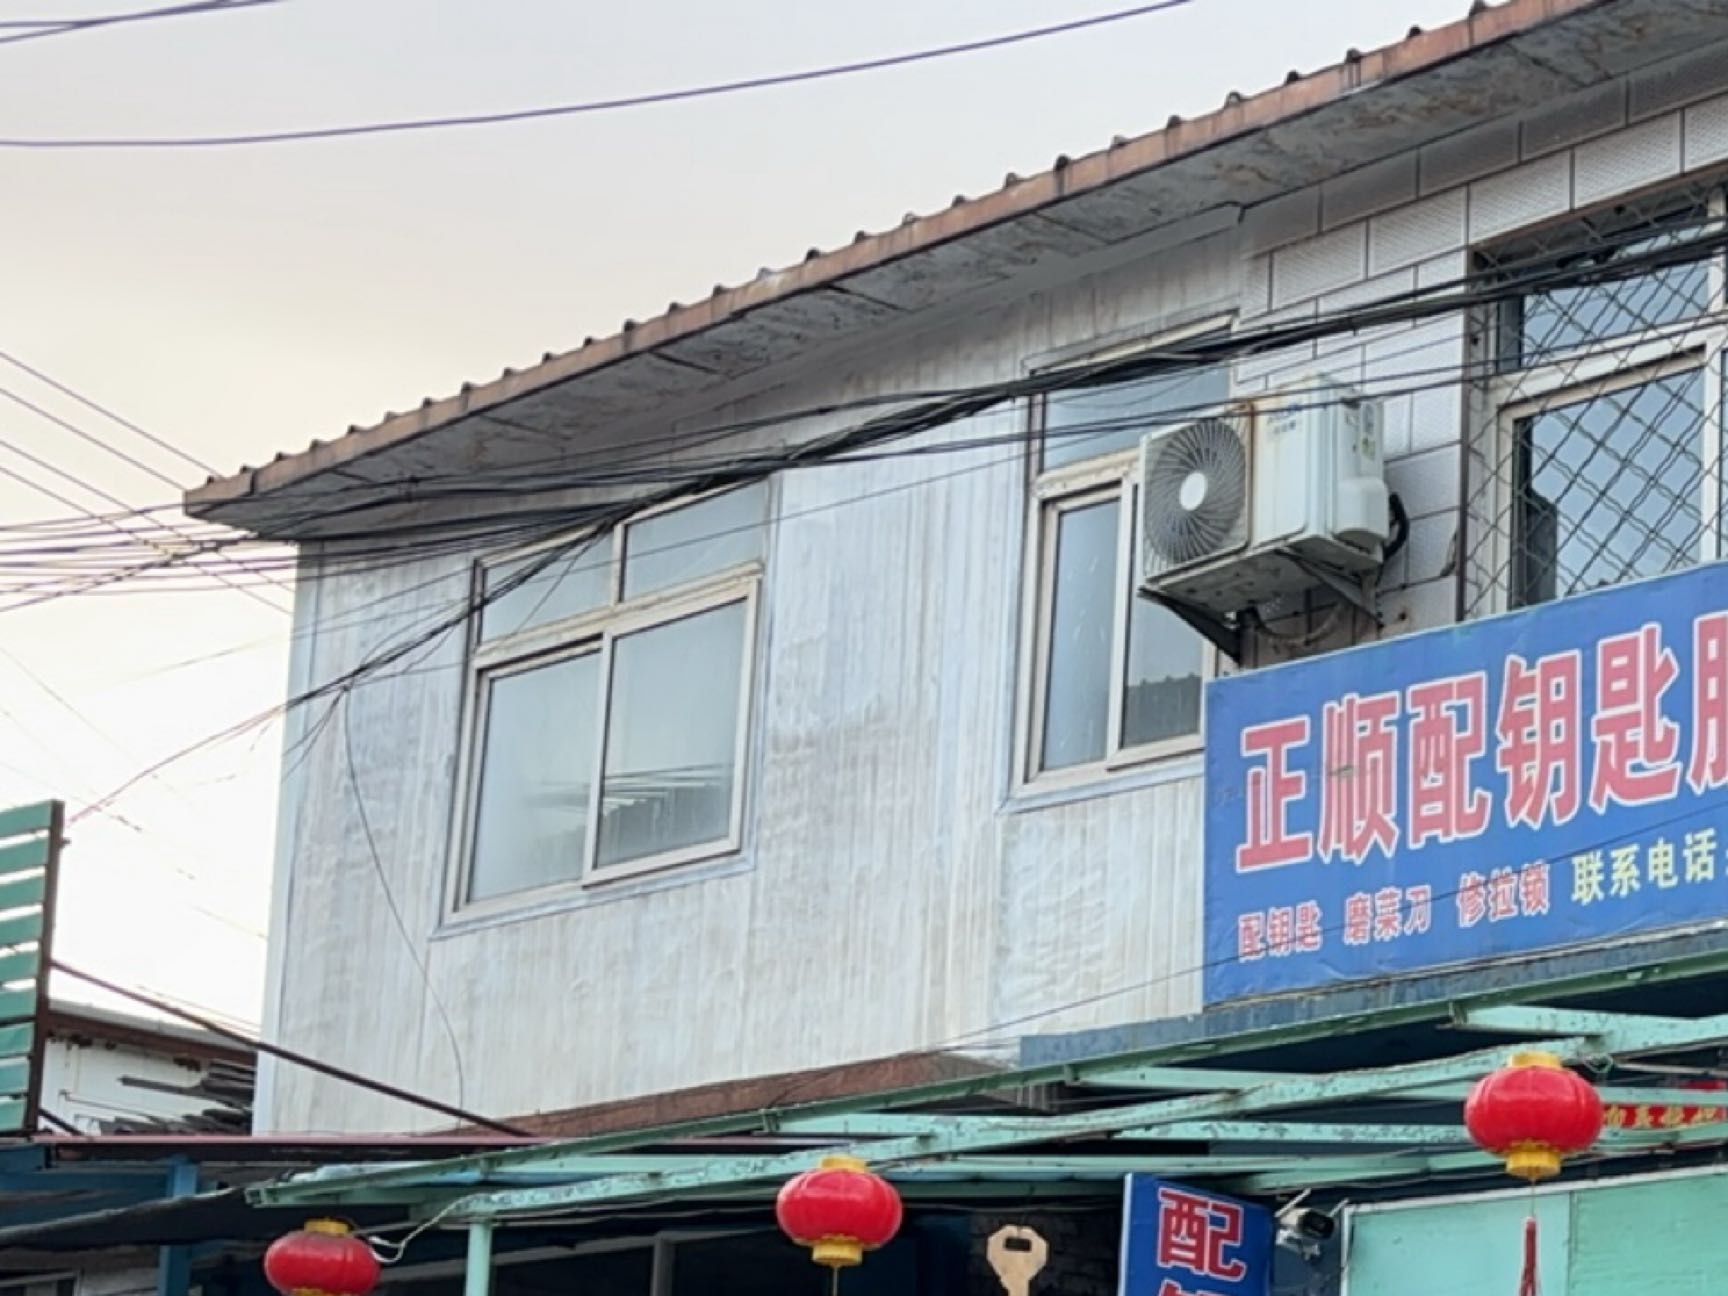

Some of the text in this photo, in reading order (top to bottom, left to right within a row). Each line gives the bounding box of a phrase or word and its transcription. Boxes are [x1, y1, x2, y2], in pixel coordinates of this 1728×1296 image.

[1237, 860, 1550, 962] 配钥匙 磨菜刀 修拉锁
